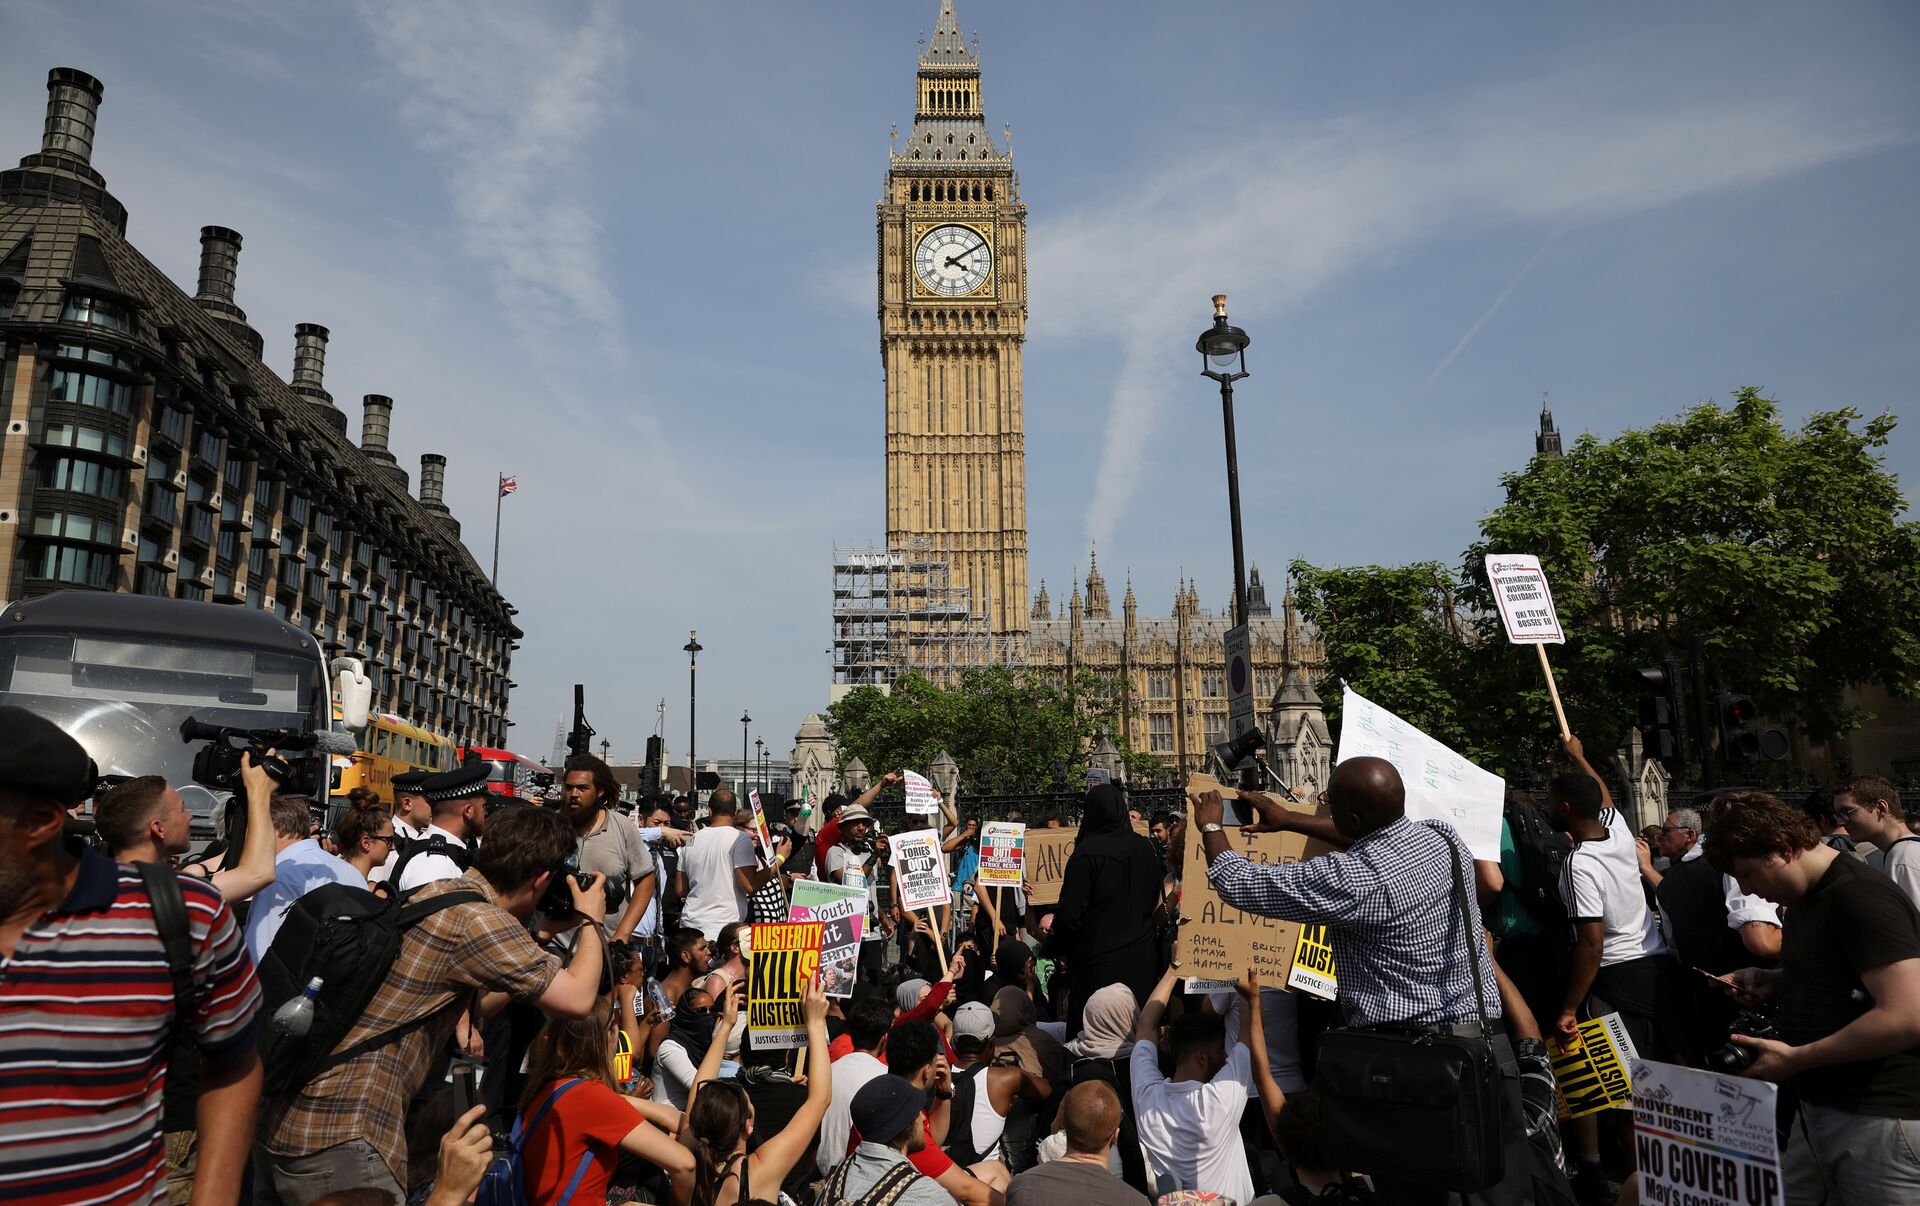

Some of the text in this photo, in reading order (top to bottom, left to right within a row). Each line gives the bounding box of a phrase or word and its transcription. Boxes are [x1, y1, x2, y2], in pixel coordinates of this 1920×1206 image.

[1496, 575, 1541, 585] INTERNATIONAL
[1506, 592, 1542, 602] SOLIDARITY
[1515, 609, 1548, 619] OXI TO THE
[1543, 618, 1553, 626] EU
[989, 838, 1017, 848] TORIES
[902, 846, 931, 858] TORIES
[993, 847, 1011, 857] OUT!
[907, 858, 931, 871] OUT!
[924, 877, 941, 886] RESIST
[798, 885, 866, 899] youthfightforjobs.com
[914, 891, 936, 899] POLICIES
[810, 899, 854, 921] Youth
[753, 924, 823, 950] AUSTERITY
[1193, 934, 1225, 947] AMAL
[1193, 947, 1227, 958] AMAYA
[1193, 958, 1233, 970] HAMME
[1253, 955, 1283, 966] BRUK
[750, 1001, 806, 1026] AUSTERI
[1578, 1023, 1632, 1102] AUSTERITY
[1633, 1096, 1714, 1125] MOVEMENT
[1634, 1111, 1714, 1141] FOR JUSTICE
[1637, 1134, 1779, 1206] NO COVER UP
[1645, 1176, 1681, 1206] May's
